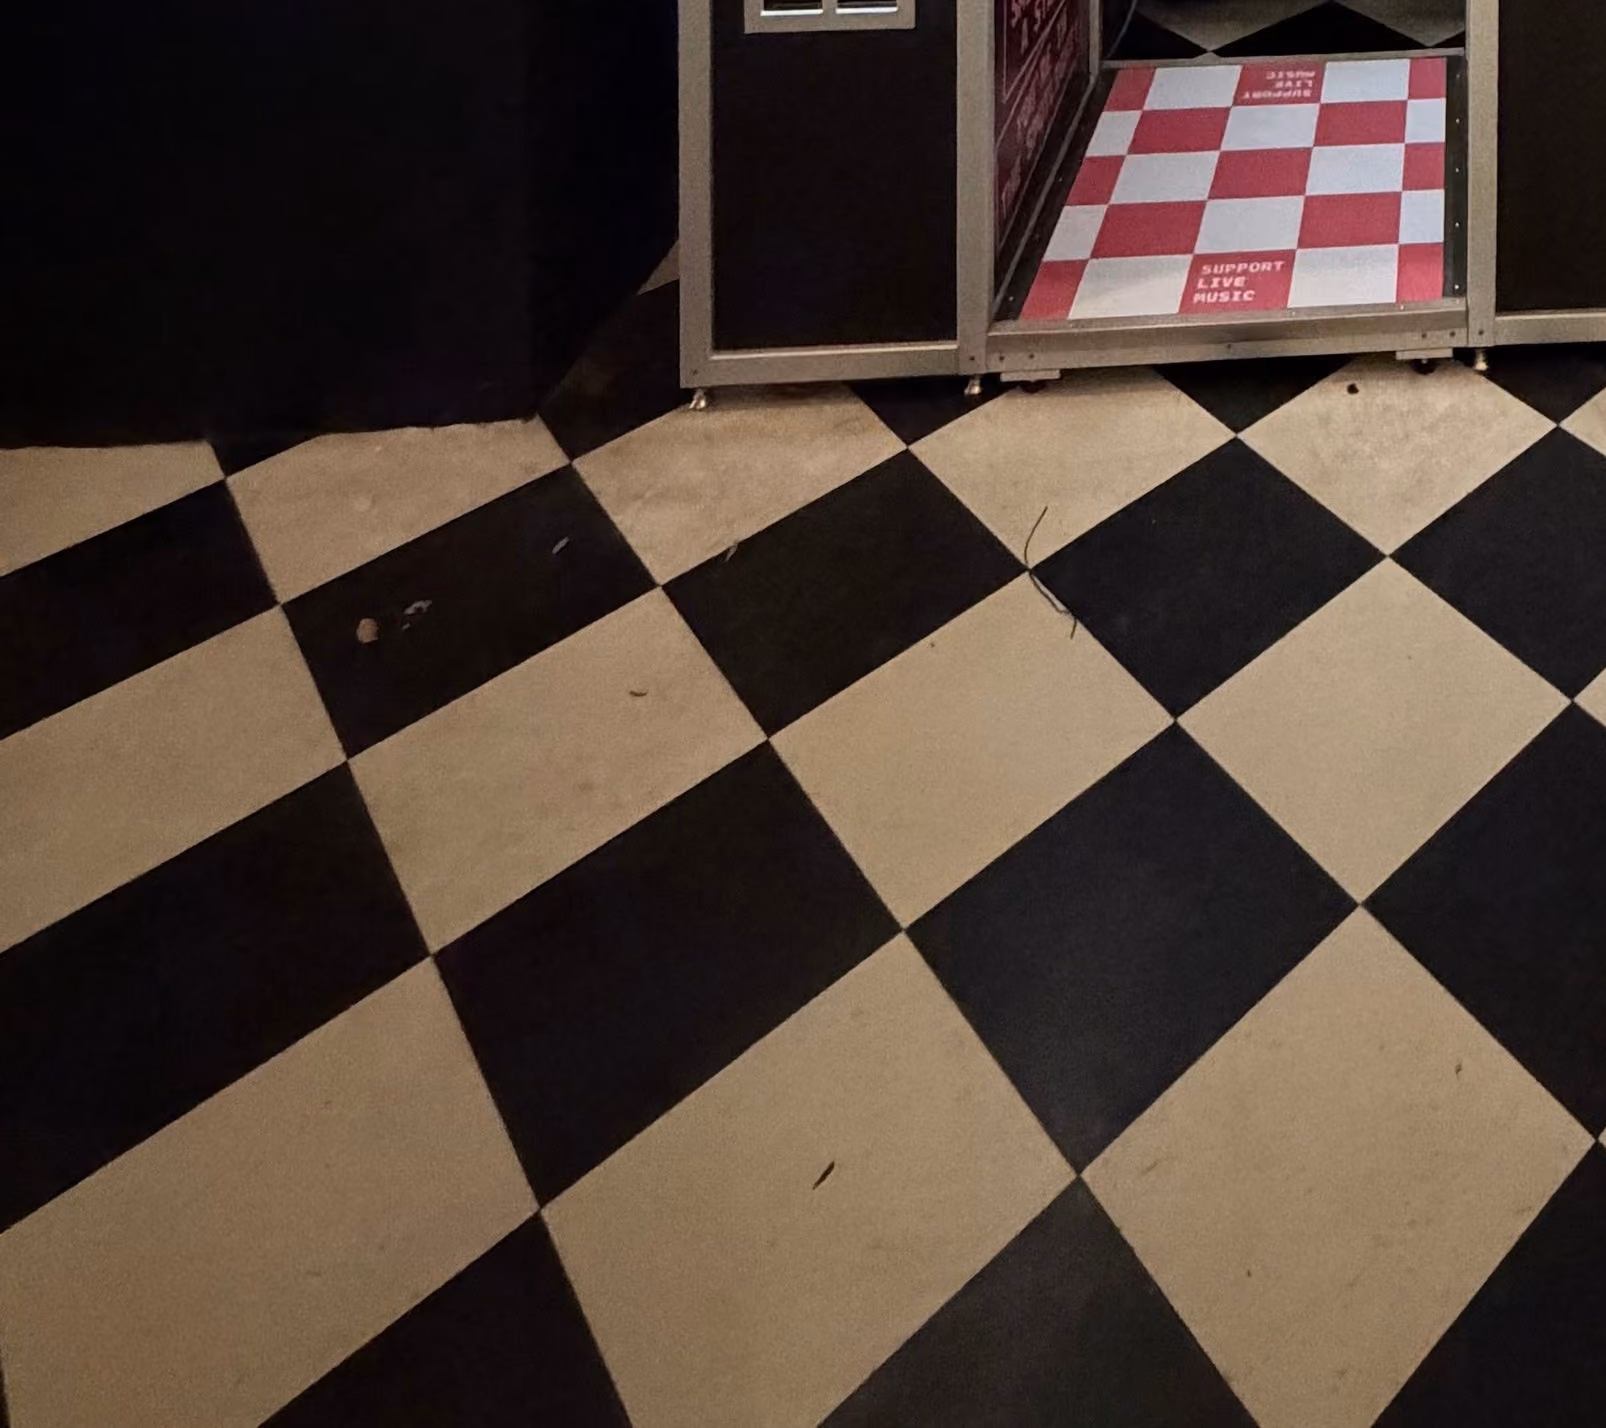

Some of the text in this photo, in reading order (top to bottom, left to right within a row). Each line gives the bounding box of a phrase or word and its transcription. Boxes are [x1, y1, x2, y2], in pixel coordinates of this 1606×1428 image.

[1265, 69, 1316, 80] MUSIC
[1274, 79, 1313, 89] LIVE
[1242, 87, 1312, 100] SUPPORT
[1202, 260, 1285, 276] SUPPORT
[1197, 275, 1246, 290] LIVE
[1193, 289, 1256, 304] MUSIC
